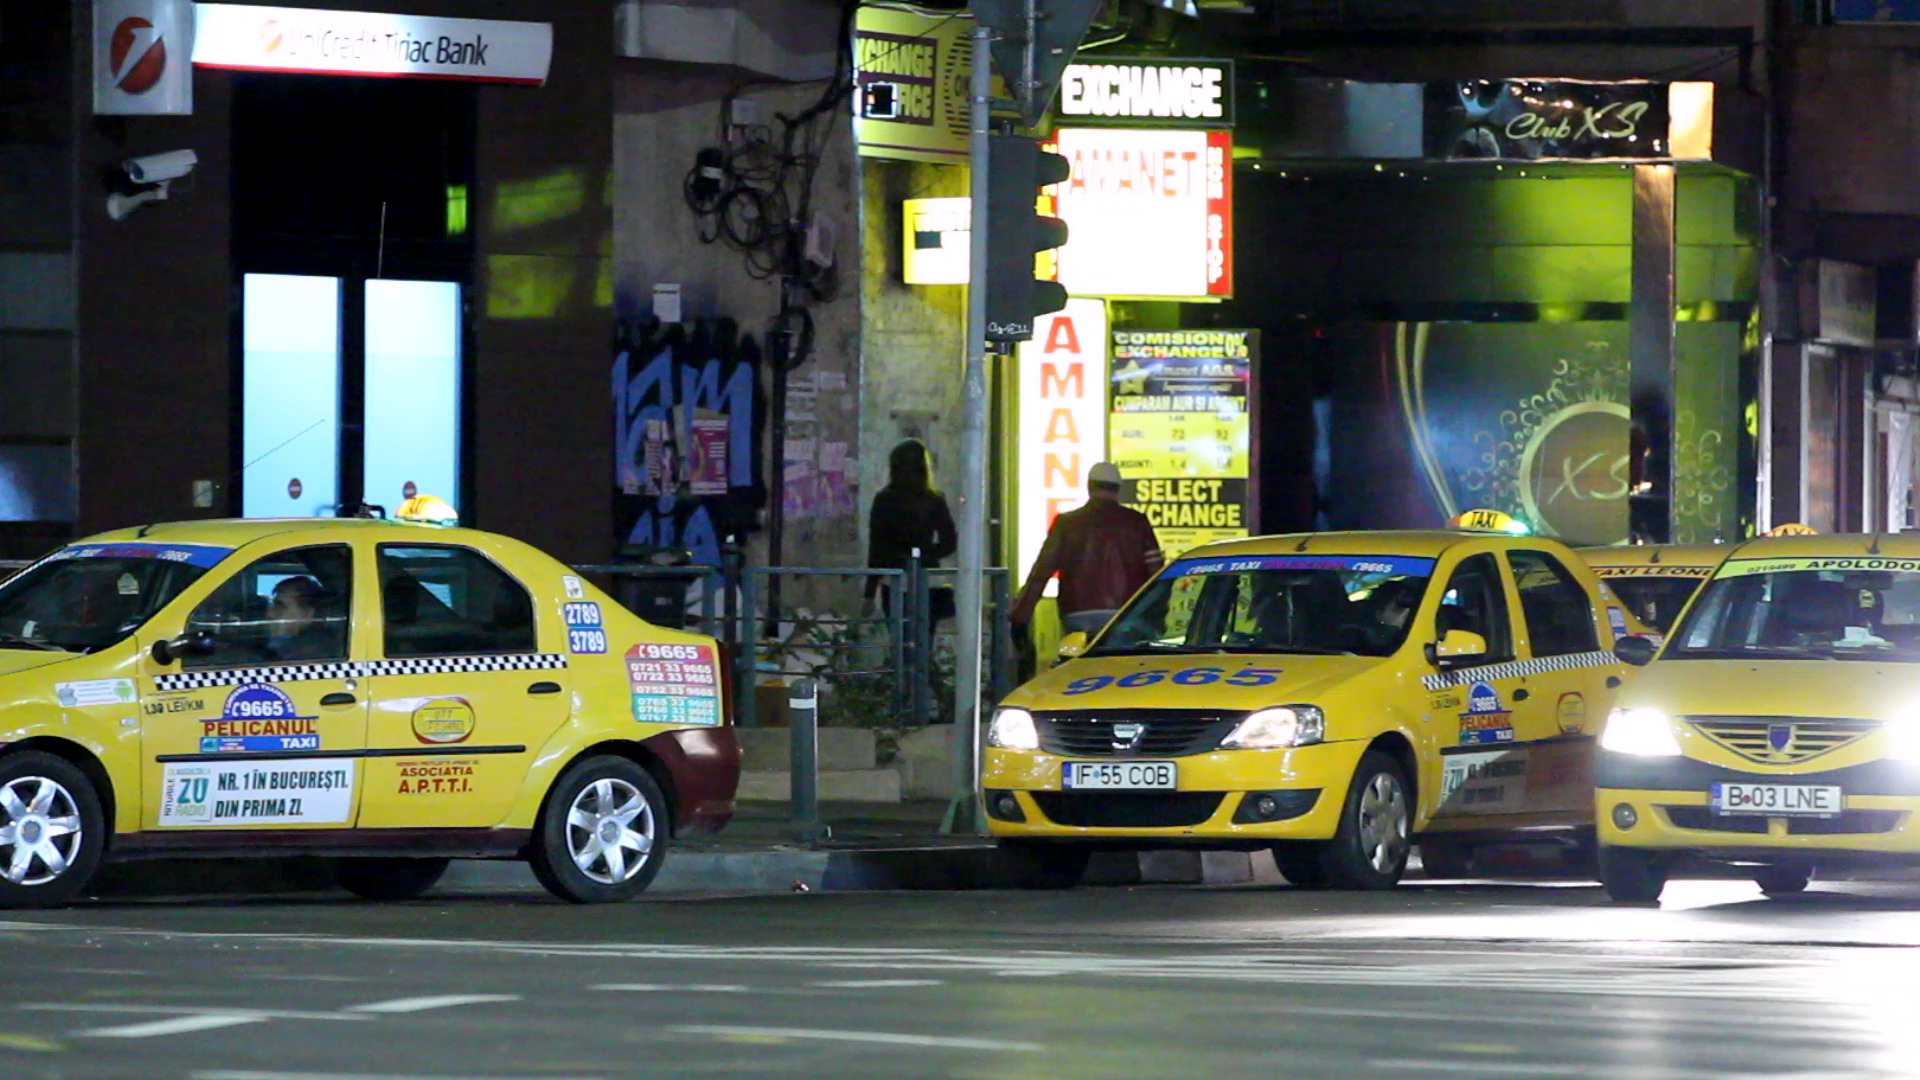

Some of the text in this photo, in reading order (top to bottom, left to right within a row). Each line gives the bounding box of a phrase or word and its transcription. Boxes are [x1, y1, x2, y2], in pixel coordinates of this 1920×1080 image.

[436, 35, 487, 66] Bank
[1062, 65, 1223, 118] EXCHANGE
[1505, 101, 1649, 141] Club XS
[1070, 149, 1198, 197] AMANET
[1115, 333, 1224, 345] COMISION
[1115, 345, 1224, 358] EXCHANGE
[1040, 316, 1084, 535] AMAN
[1136, 480, 1222, 502] SELECT
[1121, 503, 1241, 527] CHANGE
[1472, 511, 1498, 529] TAXI
[1230, 561, 1261, 571] TAXI
[565, 603, 599, 624] 2789
[570, 630, 604, 652] 3789
[647, 645, 698, 660] 9665
[630, 662, 661, 672] 0721
[633, 672, 664, 681] 0722
[1062, 667, 1284, 695] 9665
[241, 701, 284, 716] 9665
[204, 720, 316, 737] PELICANUL
[280, 737, 316, 749] TAXI
[217, 772, 239, 790] NR.
[243, 773, 249, 789] 1
[400, 767, 473, 777] ASOCIATIA
[1076, 765, 1170, 785] IF 55 COB
[177, 778, 209, 803] ZU
[398, 778, 473, 794] A.P.T.T.I.
[1729, 787, 1829, 808] B 03 LNE
[214, 798, 303, 818] DIN PRIMA ZI.
